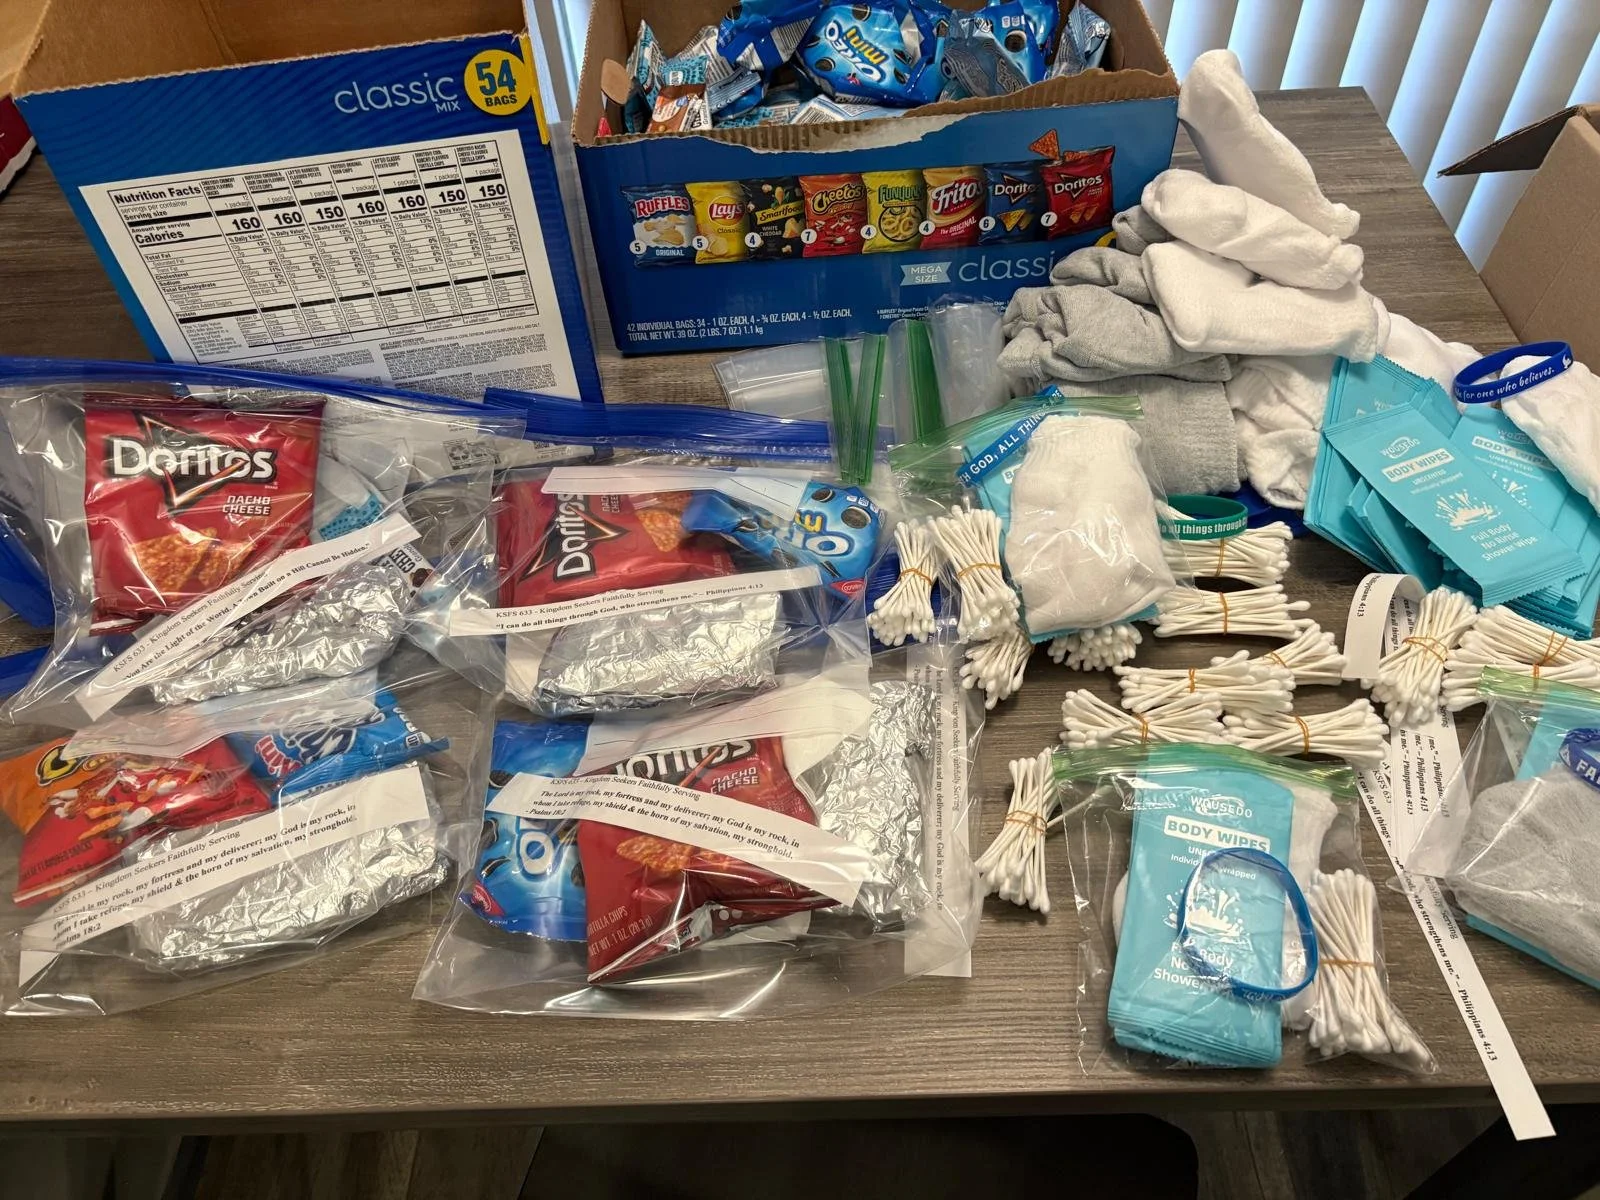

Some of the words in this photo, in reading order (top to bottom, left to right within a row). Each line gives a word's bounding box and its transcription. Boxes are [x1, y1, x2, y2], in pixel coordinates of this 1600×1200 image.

[825, 20, 882, 82] OREO
[844, 28, 886, 64] mini
[475, 59, 516, 97] 54
[334, 72, 458, 114] classic
[484, 94, 518, 107] BAGS
[434, 100, 461, 113] MIX
[113, 188, 167, 205] Nutrition
[168, 185, 201, 197] Facts
[994, 181, 1037, 196] Dorito
[1054, 174, 1103, 194] Doritos
[635, 195, 690, 218] RUFFLES
[812, 184, 863, 213] Cheetos
[931, 178, 984, 215] Fritos
[123, 211, 152, 221] Serving
[153, 209, 167, 217] size
[135, 229, 185, 245] Calories
[232, 216, 261, 231] 160
[274, 211, 303, 226] 160
[315, 206, 344, 220] 150
[357, 200, 385, 215] 160
[397, 194, 426, 209] 160
[438, 189, 466, 203] 150
[478, 183, 506, 198] 150
[949, 216, 977, 233] ORIGINAL
[131, 224, 155, 233] Amount
[655, 248, 686, 257] ORIGINAL
[911, 265, 942, 275] MEGA
[915, 273, 938, 283] SIZE
[958, 250, 1056, 282] classi
[636, 321, 674, 332] INDIVIDUAL
[675, 320, 696, 330] BAGS:
[697, 319, 706, 328] 34
[781, 312, 801, 322] EACH,
[628, 332, 649, 342] TOTAL
[649, 331, 663, 340] NET
[707, 327, 722, 337] LBS.
[1463, 391, 1475, 402] for
[1476, 391, 1495, 399] one
[1497, 381, 1517, 395] who
[1519, 366, 1555, 387] believes.
[969, 454, 999, 474] GOD,
[998, 433, 1020, 454] ALL
[1475, 438, 1512, 453] BODY
[113, 437, 275, 480] Doritos
[1386, 464, 1416, 479] BODY
[1416, 450, 1450, 468] WIPES
[222, 503, 271, 516] CHEESE
[227, 495, 271, 506] NACHO
[1182, 524, 1213, 535] things
[1214, 519, 1242, 533] through
[1471, 530, 1489, 542] Full
[1487, 523, 1512, 536] Body
[1495, 531, 1520, 544] Rinse
[1481, 544, 1515, 561] Shower
[1513, 536, 1539, 548] Wipe
[149, 620, 182, 644] Kingdom
[180, 603, 208, 622] Seekers
[207, 584, 241, 606] Faithfully
[165, 634, 186, 651] Light
[194, 619, 206, 631] the
[257, 577, 276, 593] Built
[291, 563, 305, 574] Hill
[305, 557, 331, 570] Cannot
[496, 610, 517, 618] KSFS
[539, 604, 573, 615] Kingdom
[574, 598, 601, 608] Seekers
[602, 591, 636, 604] Faithfully
[637, 588, 664, 598] Serving
[544, 616, 568, 625] things
[569, 610, 599, 621] through
[600, 605, 619, 613] God,
[619, 602, 636, 610] who
[636, 597, 680, 609] strengthens
[705, 585, 747, 596] Philippians
[710, 775, 759, 794] CHEESE
[712, 766, 758, 784] NACHO
[1372, 769, 1388, 790] KSFS
[611, 776, 638, 786] Seekers
[638, 780, 673, 795] Faithfully
[673, 786, 701, 802] Serving
[602, 791, 615, 799] my
[615, 790, 643, 803] fortress
[659, 802, 674, 811] my
[673, 804, 711, 820] deliverer;
[711, 814, 726, 825] my
[726, 816, 745, 829] God
[753, 827, 768, 838] my
[768, 830, 790, 846] rock,
[791, 838, 800, 848] in
[1189, 795, 1253, 819] WOUSEDO
[604, 801, 627, 812] shield
[636, 806, 650, 816] the
[650, 811, 669, 822] horn
[680, 817, 693, 829] my
[693, 820, 731, 838] salvation,
[731, 831, 746, 843] my
[747, 835, 794, 860] stronghold.
[1167, 819, 1214, 842] BODY
[1217, 830, 1268, 851] WIPES
[95, 873, 132, 893] Kingdom
[134, 858, 166, 876] Seekers
[167, 842, 207, 863] Faithfully
[208, 830, 241, 847] Serving
[96, 898, 110, 911] my
[135, 881, 150, 894] my
[150, 867, 185, 885] fortress
[185, 859, 203, 871] and
[203, 853, 219, 867] my
[220, 838, 263, 858] deliverer;
[264, 831, 278, 843] my
[280, 823, 299, 836] God
[308, 816, 323, 827] my
[323, 806, 347, 820] rock,
[79, 912, 99, 925] take
[130, 893, 146, 906] my
[146, 882, 173, 898] shield
[174, 877, 184, 887] &
[184, 871, 200, 883] the
[201, 862, 222, 876] horn
[234, 854, 250, 865] my
[250, 839, 293, 858] salvation,
[293, 832, 307, 844] my
[608, 905, 628, 924] CHIPS
[83, 922, 102, 936] 18:2
[1421, 910, 1447, 958] strengthens
[1458, 988, 1486, 1039] Philippians
[1483, 1040, 1498, 1061] 4:13
